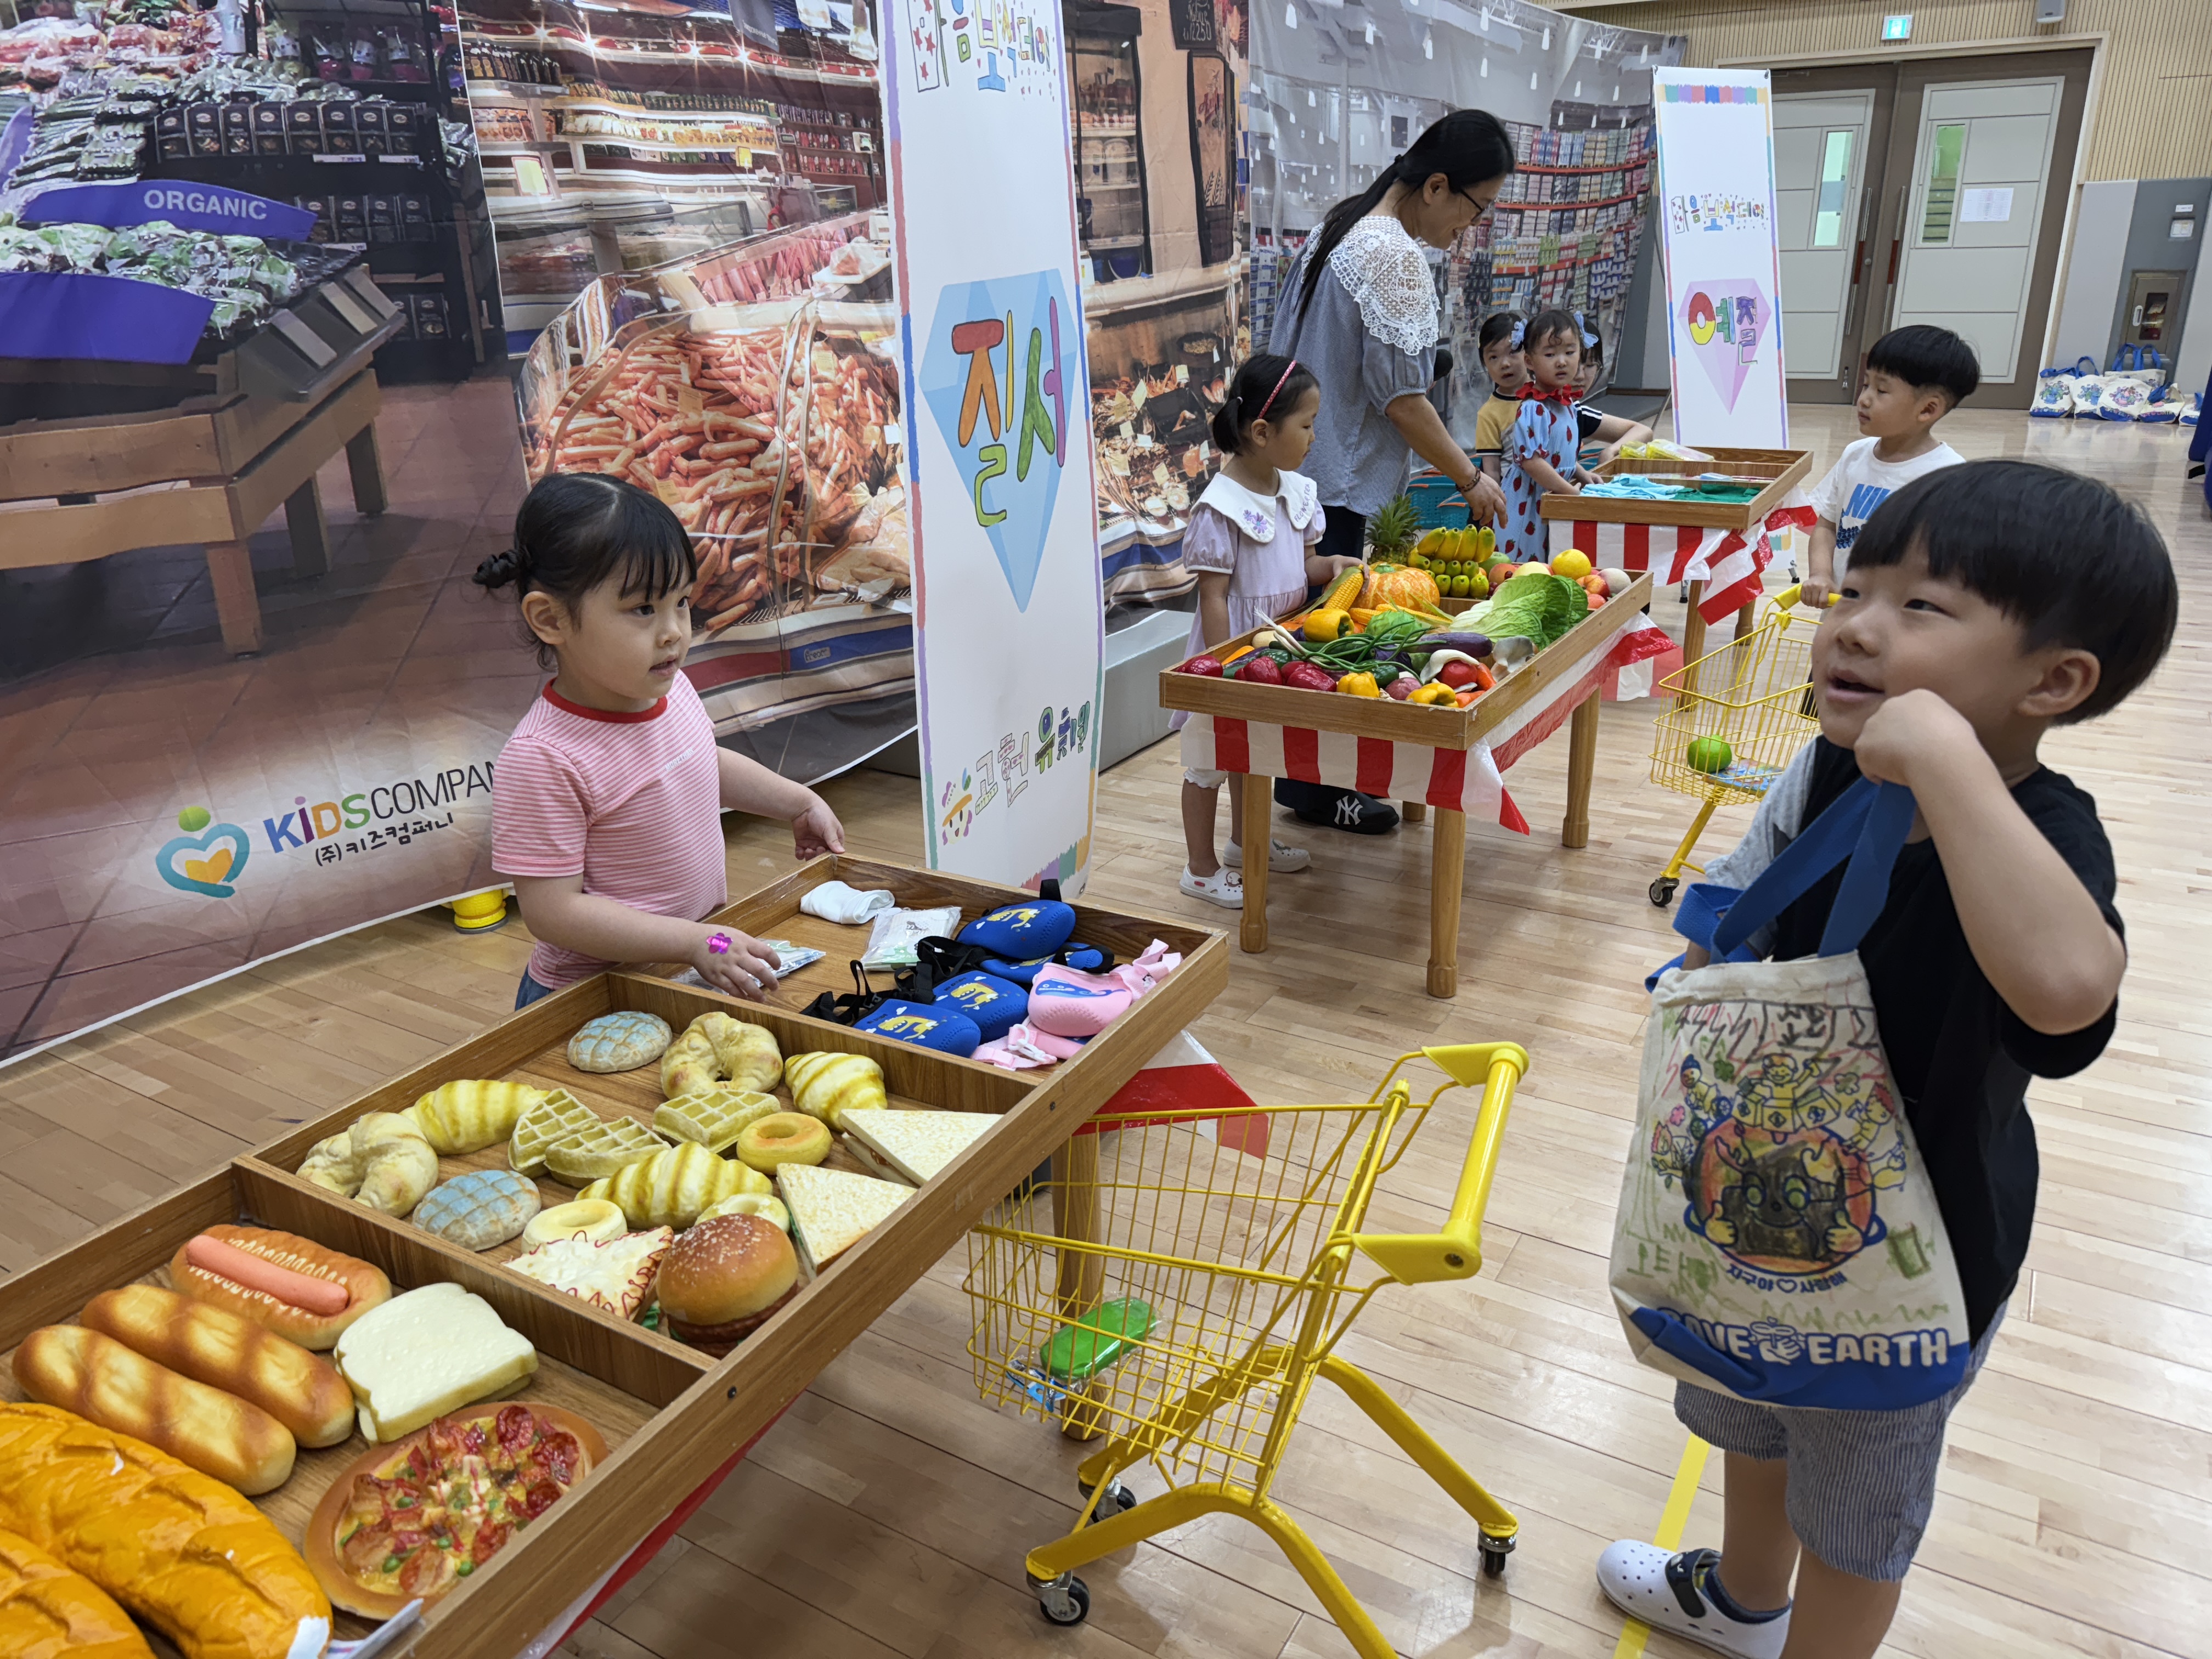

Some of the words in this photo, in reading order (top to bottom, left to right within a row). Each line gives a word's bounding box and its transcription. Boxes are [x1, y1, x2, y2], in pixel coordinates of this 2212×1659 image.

[144, 190, 267, 220] ORGANIC
[1688, 292, 1758, 366] 예절
[951, 296, 1066, 528] 질서
[1294, 495, 1311, 522] FLOWER
[975, 731, 1029, 816] 고현
[1035, 701, 1091, 775] 유치원
[1334, 795, 1363, 825] NY
[1726, 1263, 1774, 1291] 지구야
[1800, 1271, 1848, 1293] 사랑해
[1656, 1306, 1753, 1361] AVE
[1807, 1327, 1951, 1368] EARTH
